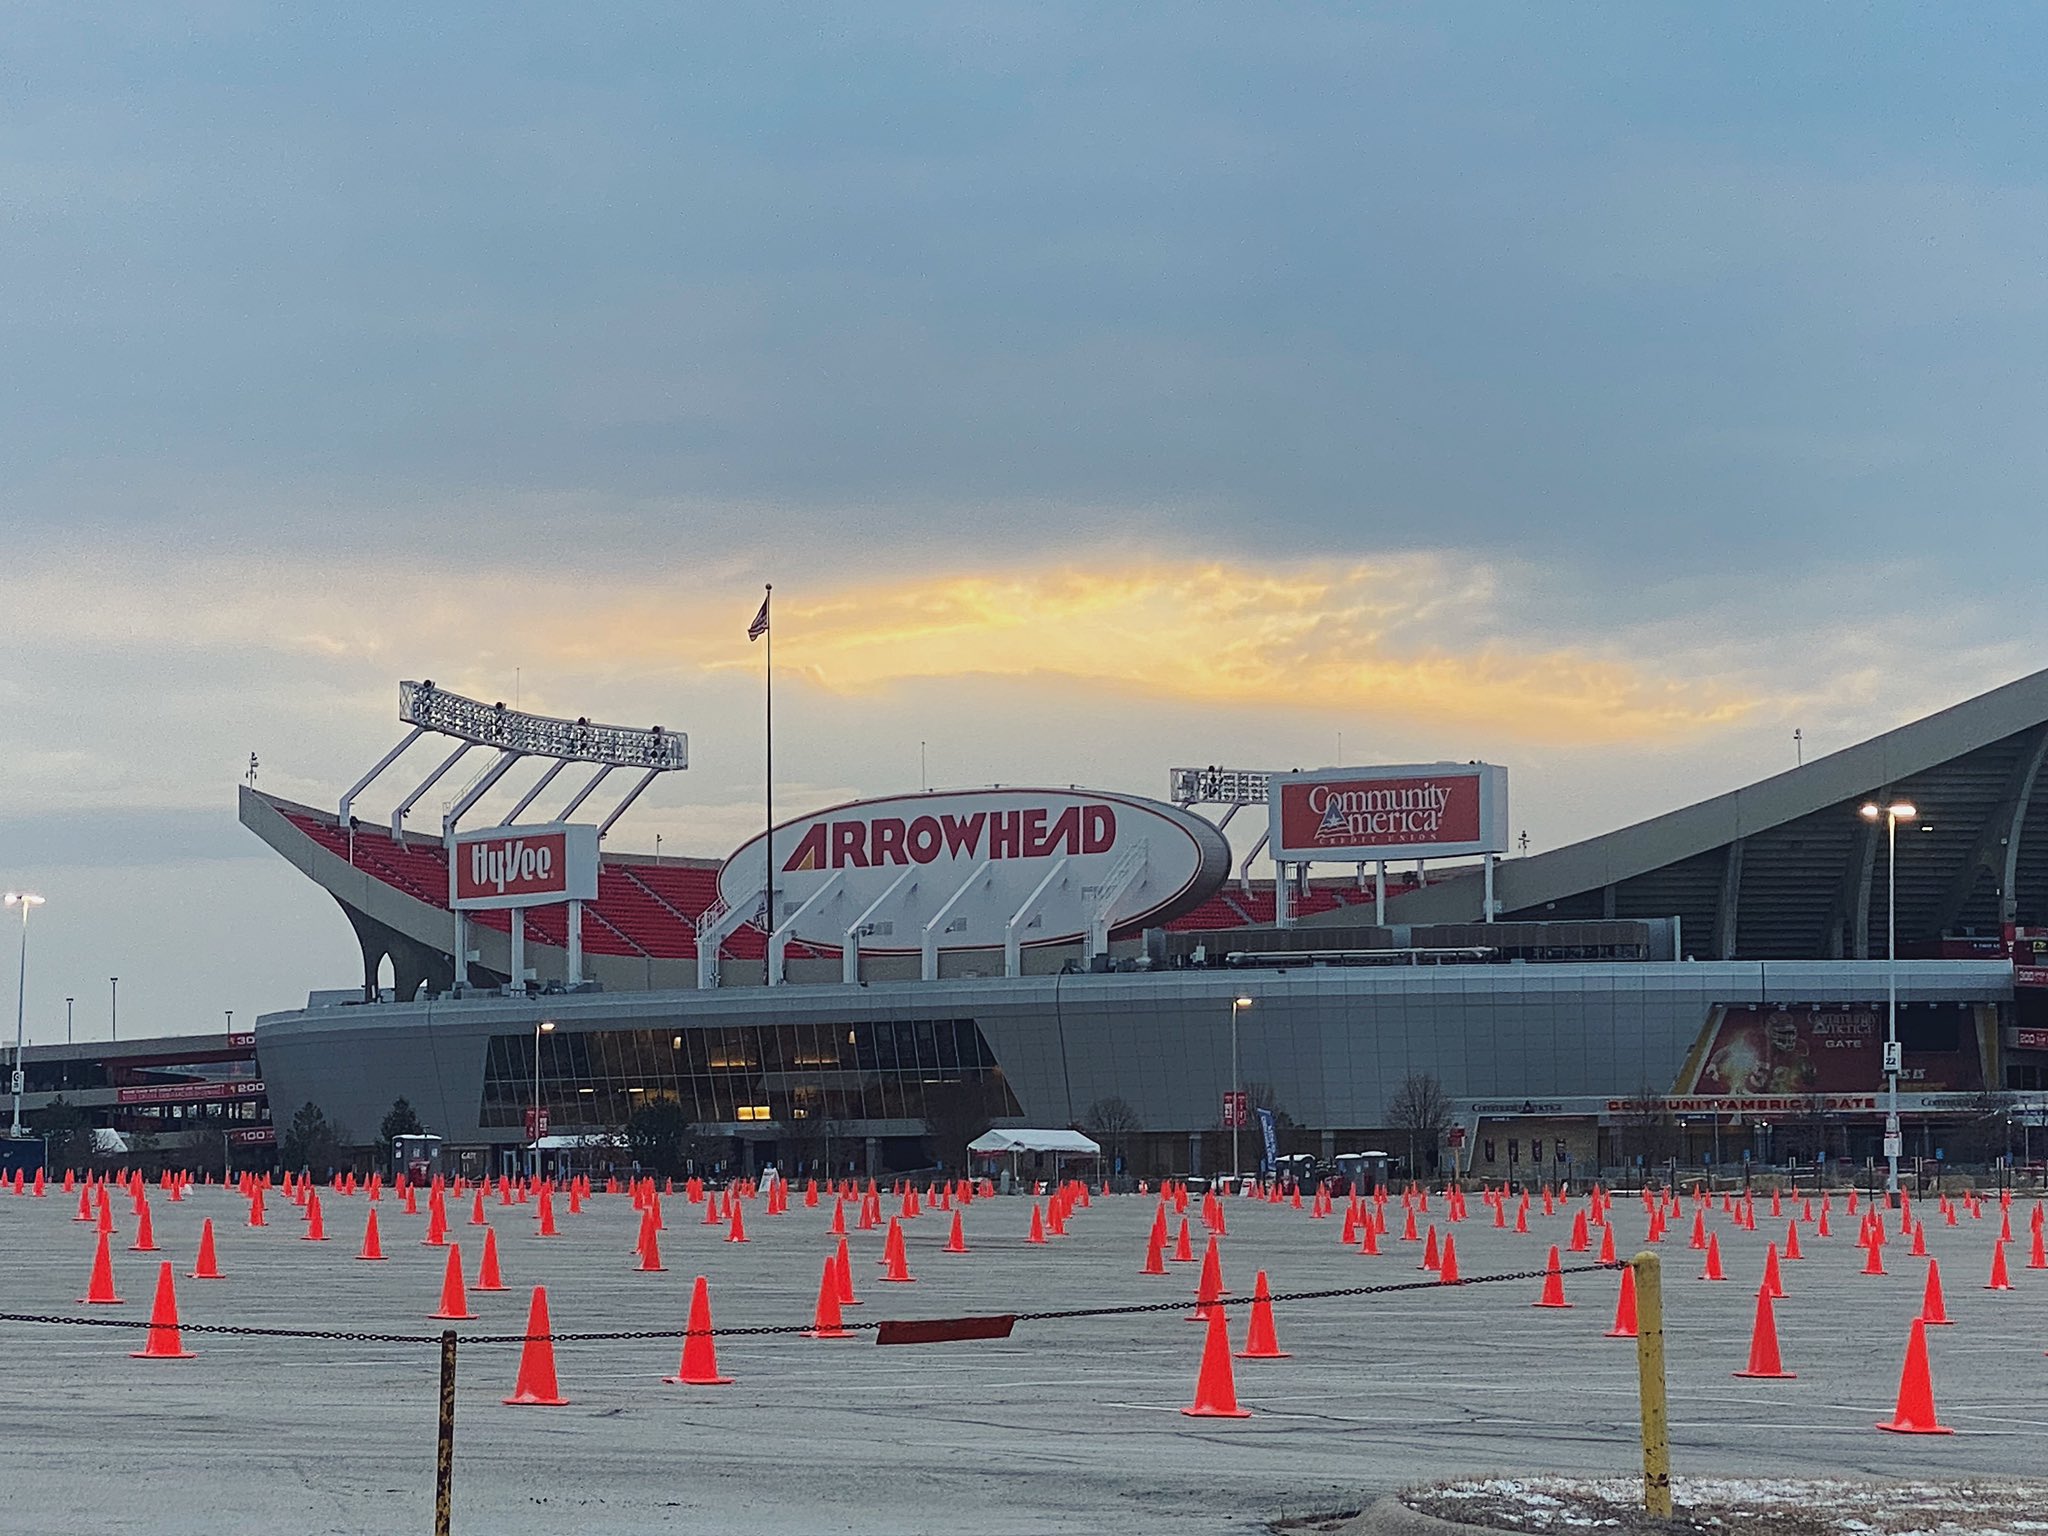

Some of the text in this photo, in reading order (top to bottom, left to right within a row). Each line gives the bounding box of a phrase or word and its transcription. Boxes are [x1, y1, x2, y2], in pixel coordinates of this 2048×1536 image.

[1309, 782, 1452, 817] Community
[1314, 799, 1439, 839] America
[782, 805, 1116, 872] ARROWHEAD
[1825, 1040, 1862, 1048] GATE
[1887, 1043, 1896, 1057] F
[1886, 1057, 1896, 1065] 22
[237, 1082, 265, 1093] 200
[240, 1131, 265, 1141] 100
